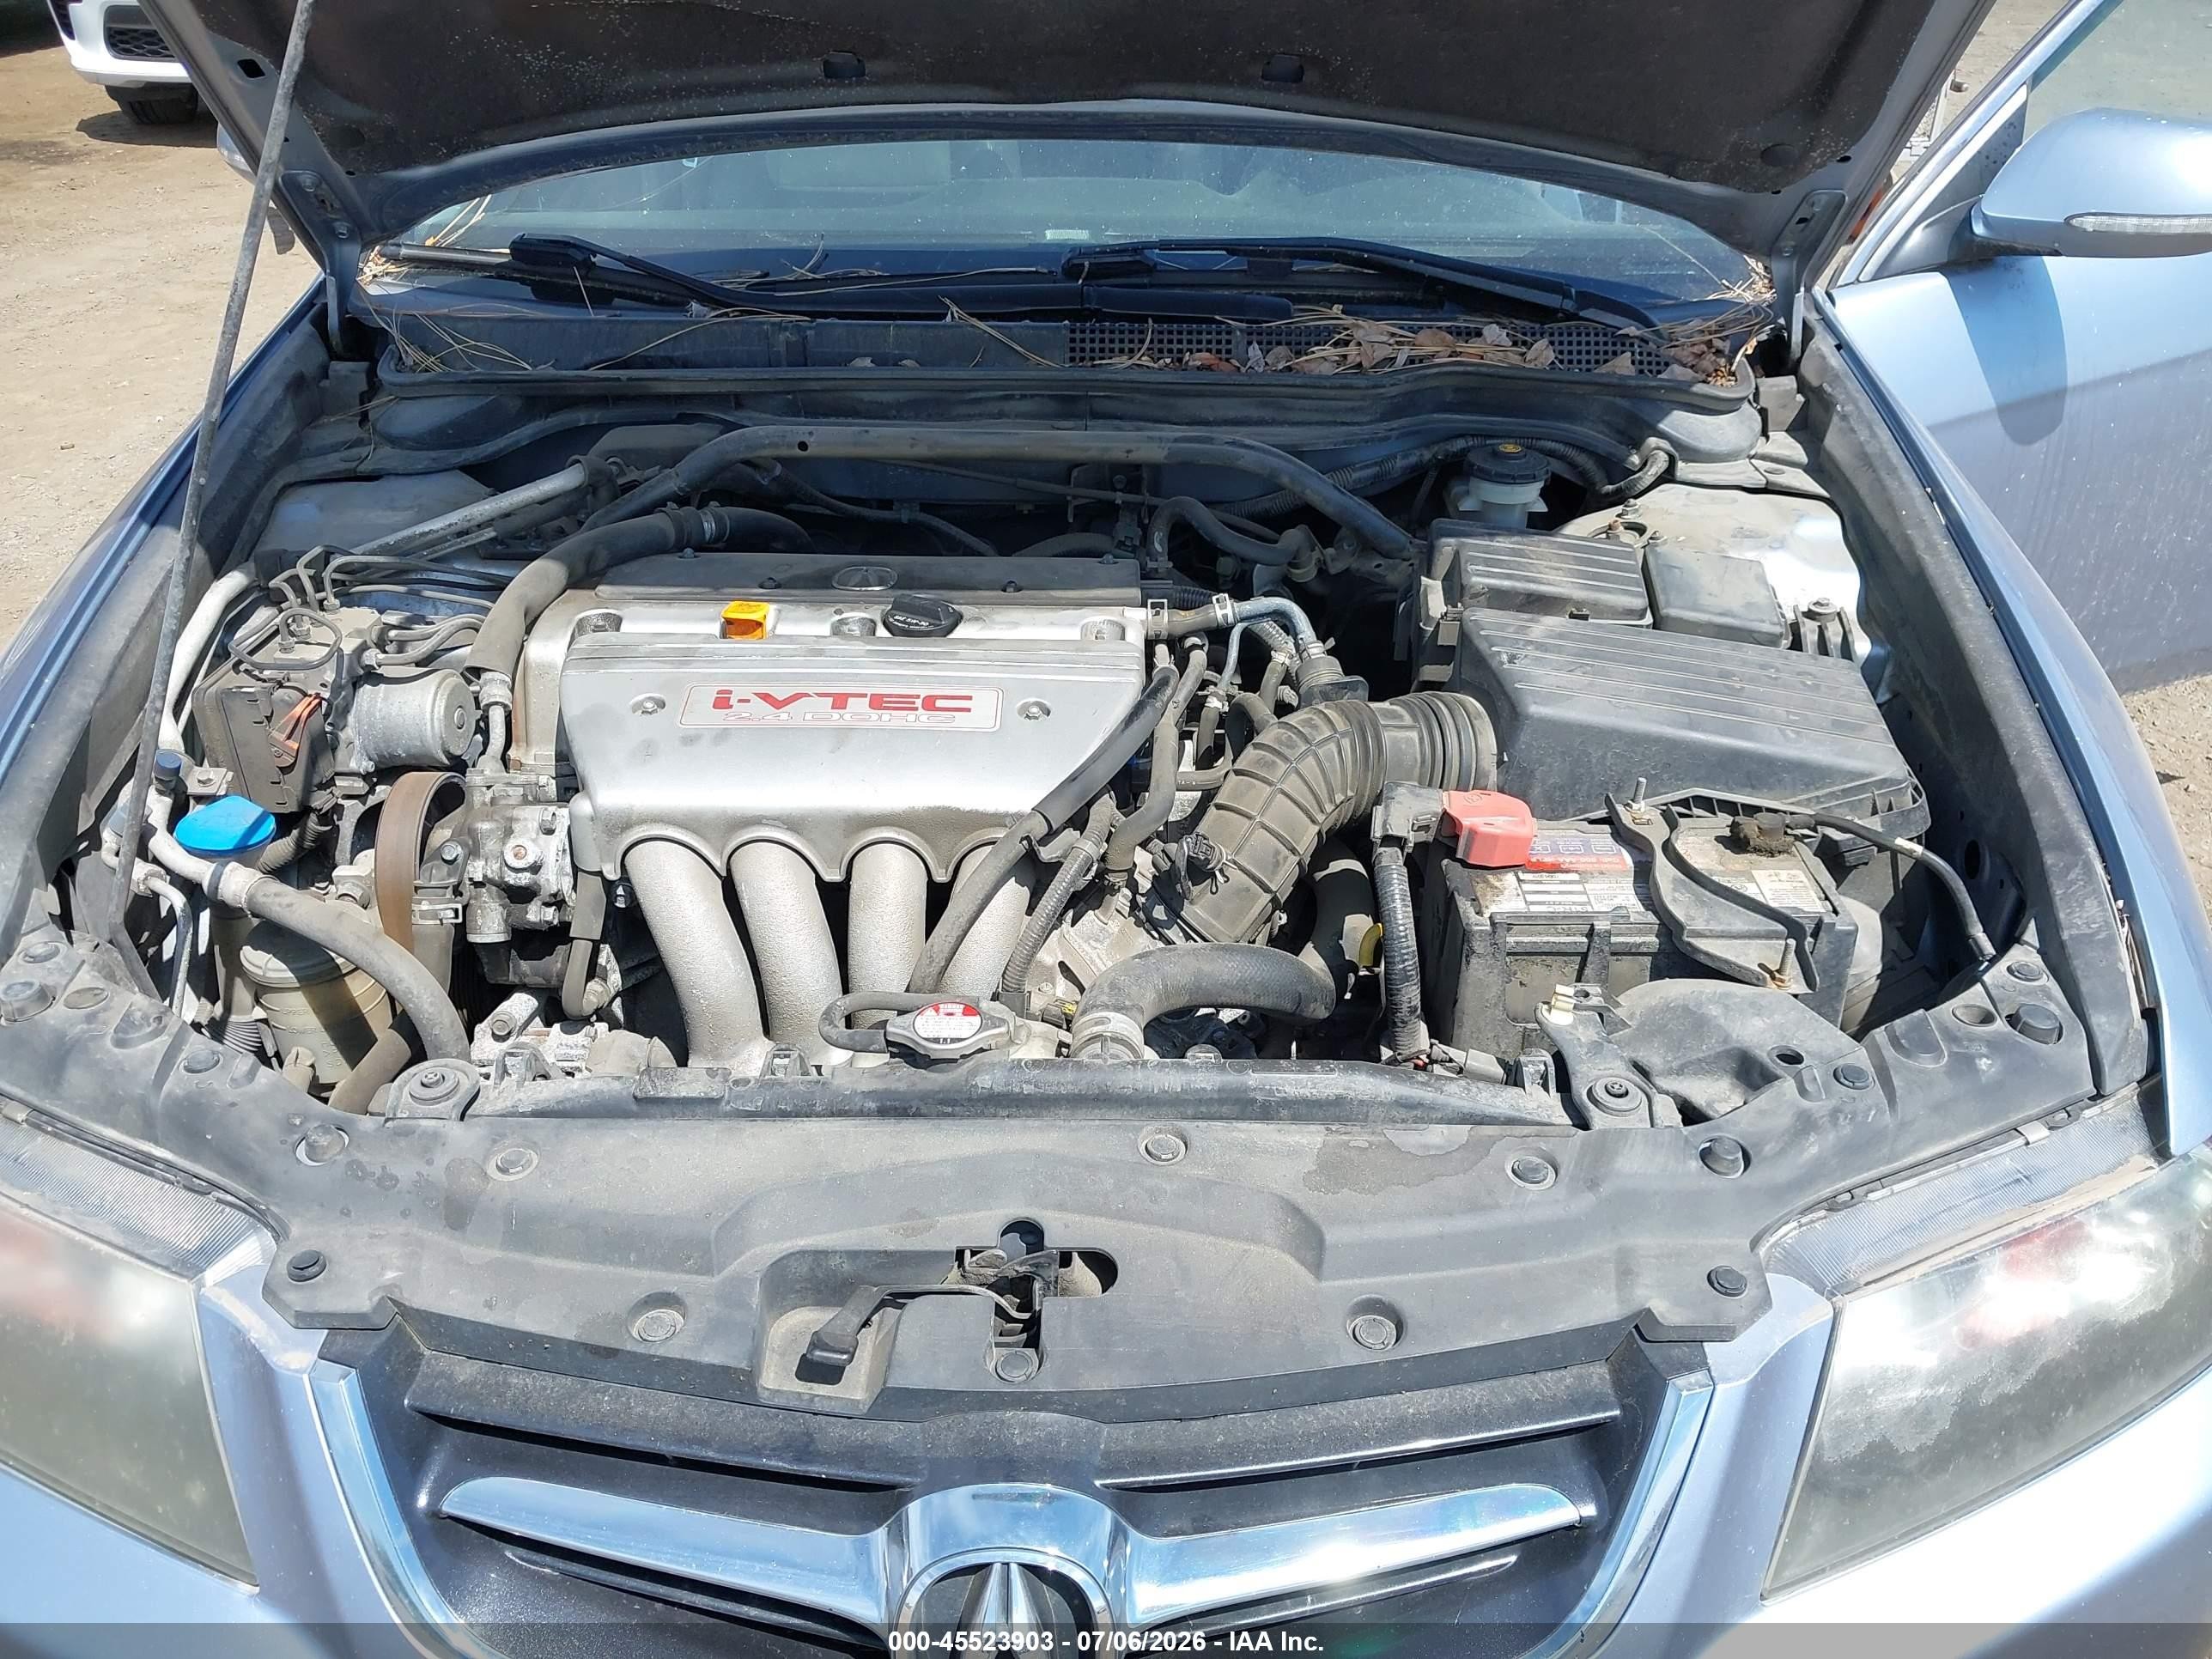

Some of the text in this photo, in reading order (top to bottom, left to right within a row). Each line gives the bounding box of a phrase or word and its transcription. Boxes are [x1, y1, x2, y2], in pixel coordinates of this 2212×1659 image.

[712, 689, 974, 714] i-VTEC
[722, 711, 957, 724] 2.4 DOHC
